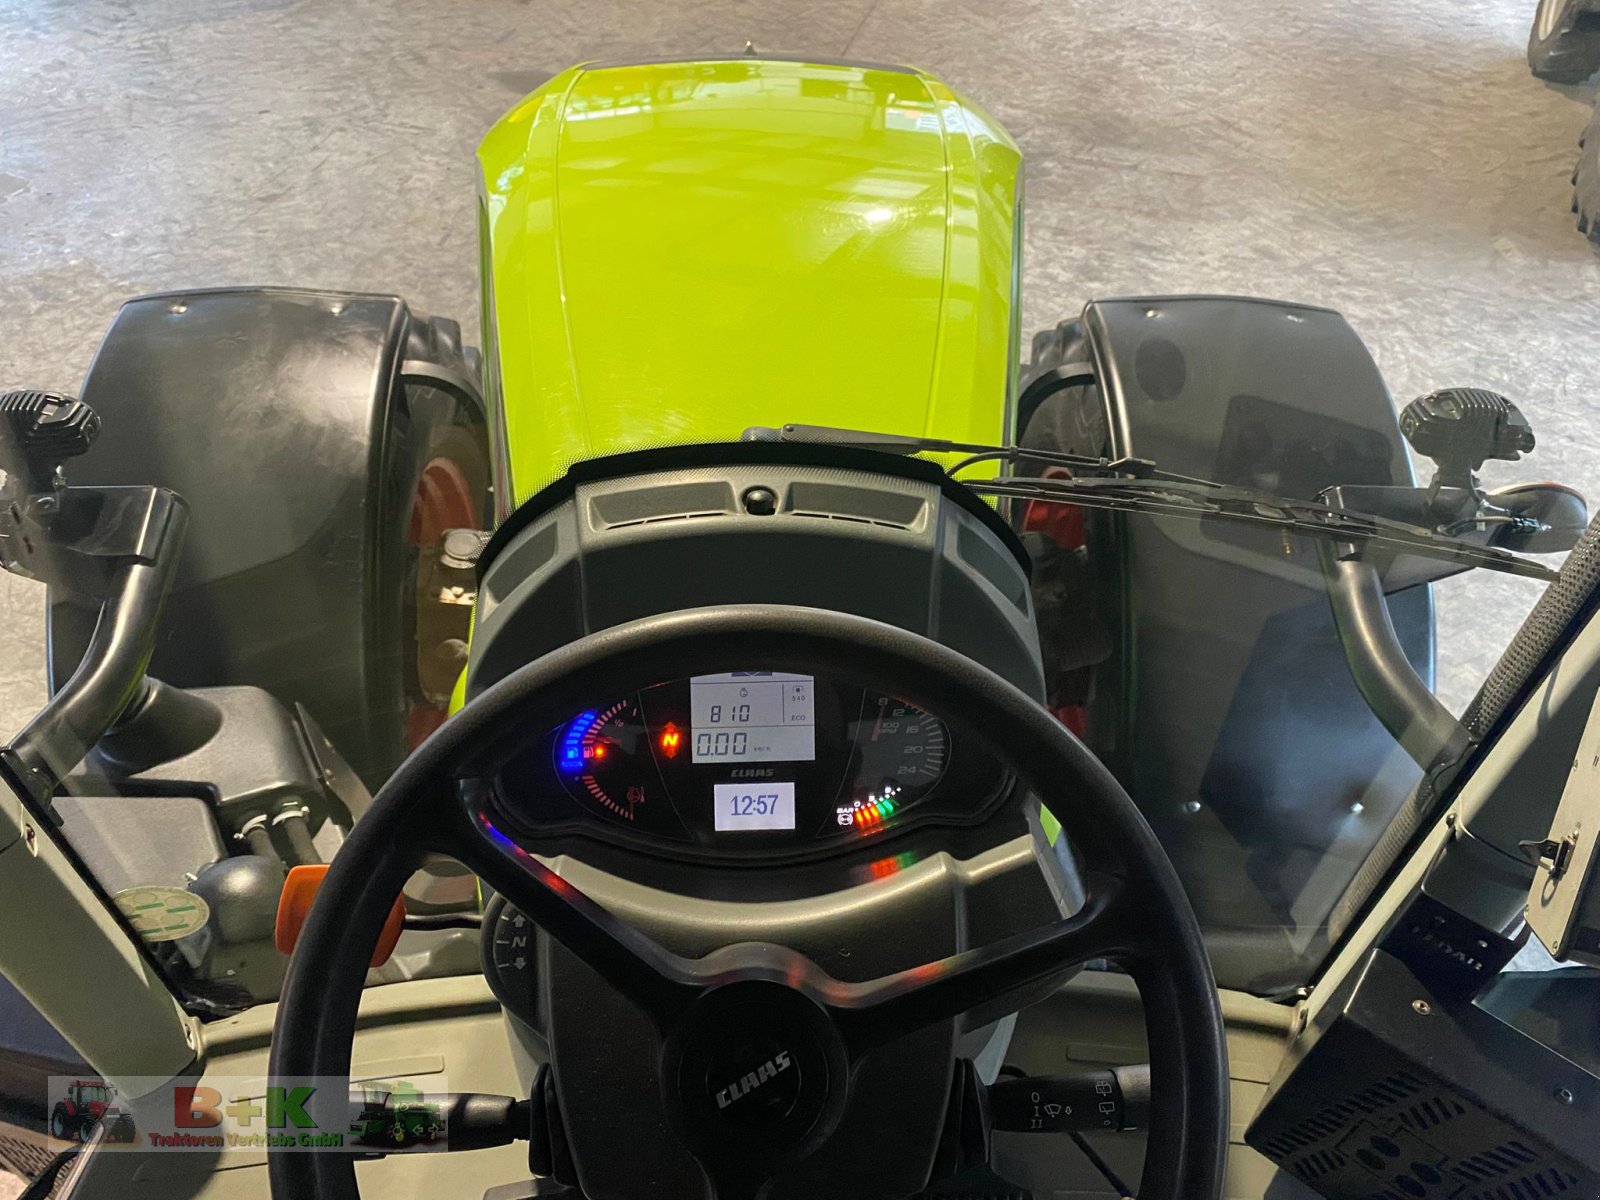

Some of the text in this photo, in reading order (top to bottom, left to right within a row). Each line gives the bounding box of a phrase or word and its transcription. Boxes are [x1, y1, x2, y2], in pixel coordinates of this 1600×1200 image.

[710, 704, 750, 723] 810
[892, 708, 905, 717] 12
[906, 725, 919, 734] 16
[663, 733, 679, 746] N
[696, 732, 747, 756] 0.00
[903, 745, 923, 754] 20
[730, 768, 774, 778] CLAAS
[897, 766, 917, 775] 24
[730, 794, 779, 816] 12:57
[511, 935, 527, 949] N
[716, 1050, 791, 1110] CLAAS
